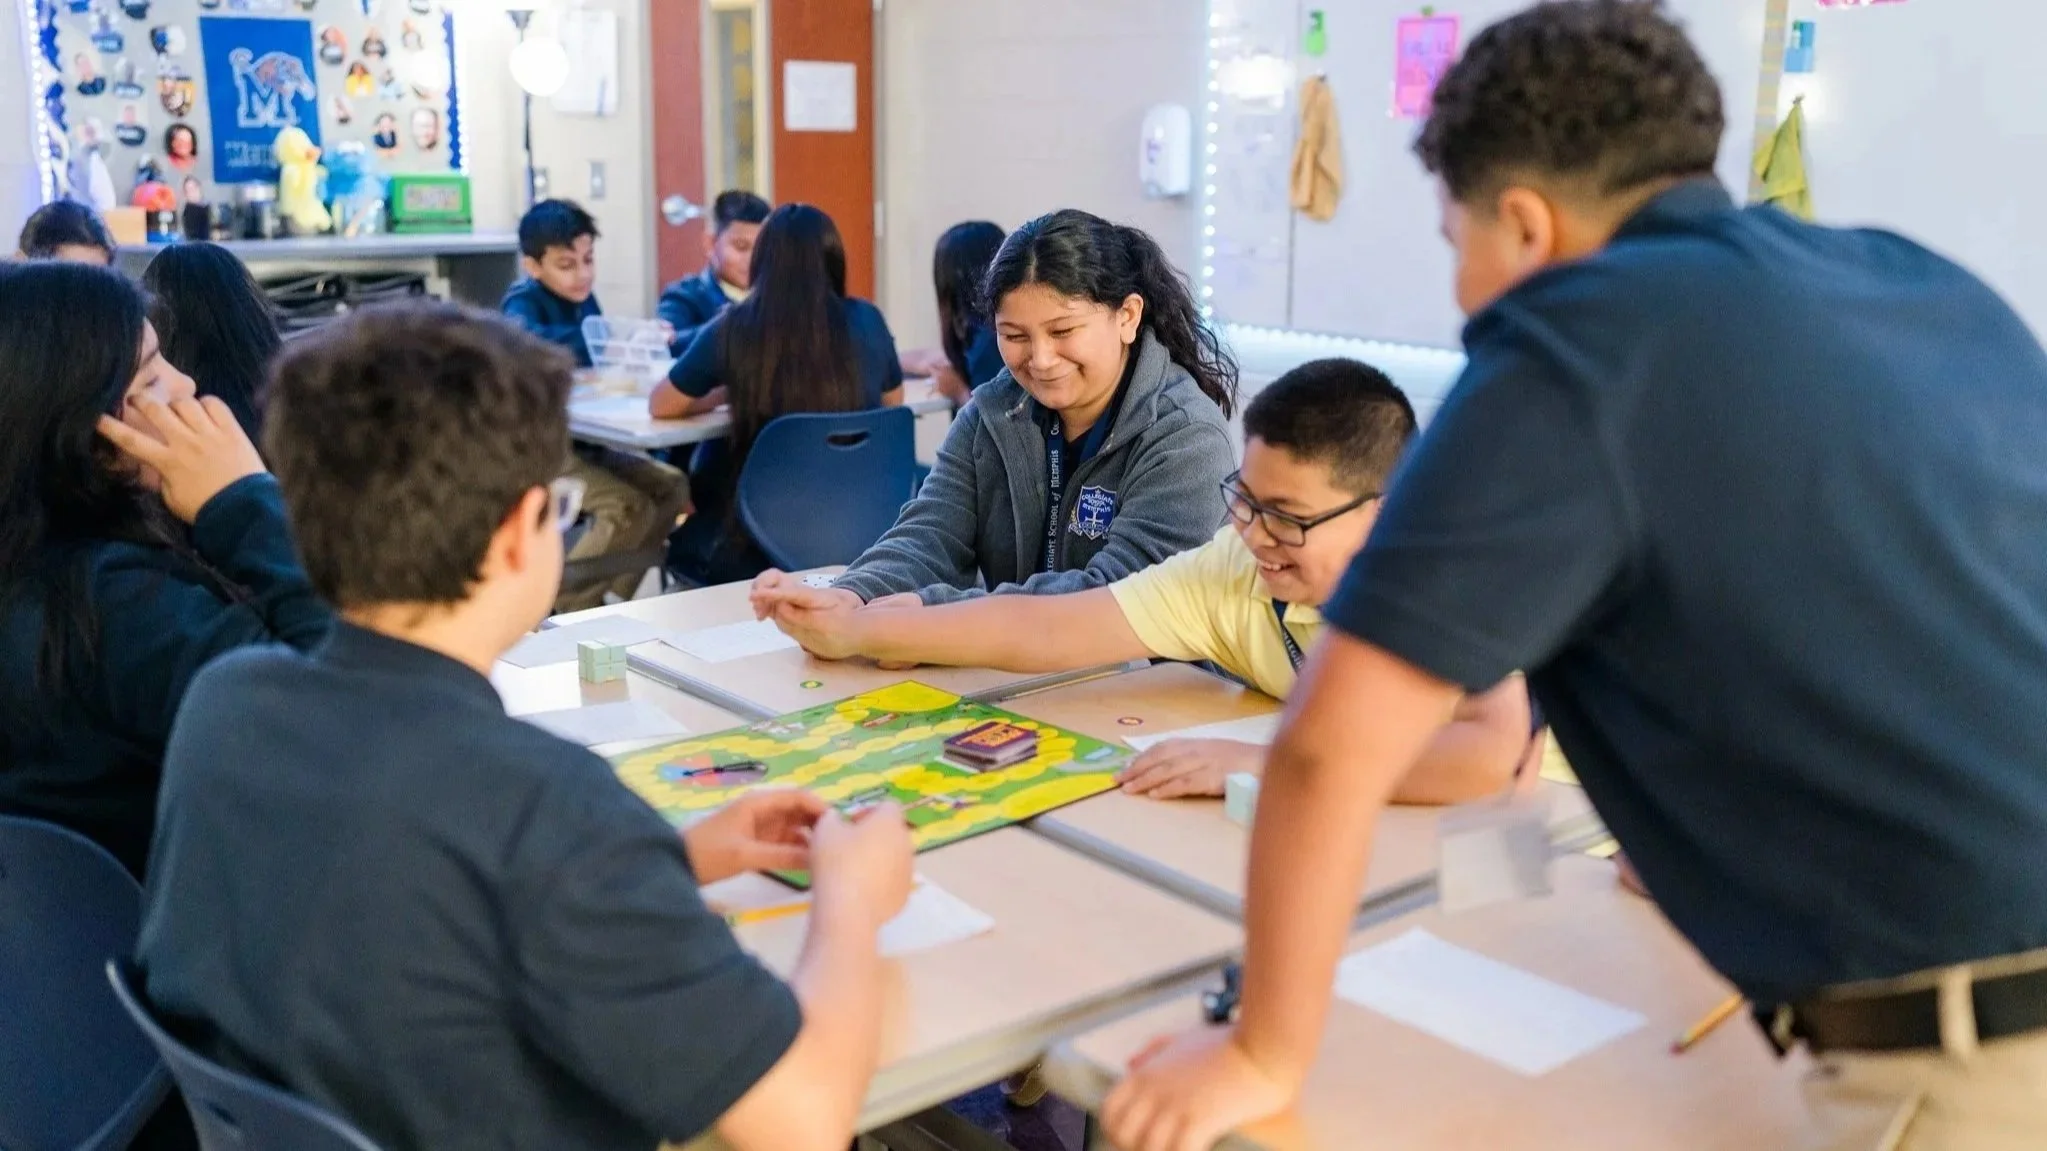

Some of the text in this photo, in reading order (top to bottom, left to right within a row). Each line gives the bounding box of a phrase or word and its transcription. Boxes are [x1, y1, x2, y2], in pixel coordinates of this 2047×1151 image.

[230, 55, 301, 128] M
[1051, 491, 1062, 501] of
[1048, 504, 1059, 536] SCHOOL
[1047, 539, 1056, 573] LEGIATE
